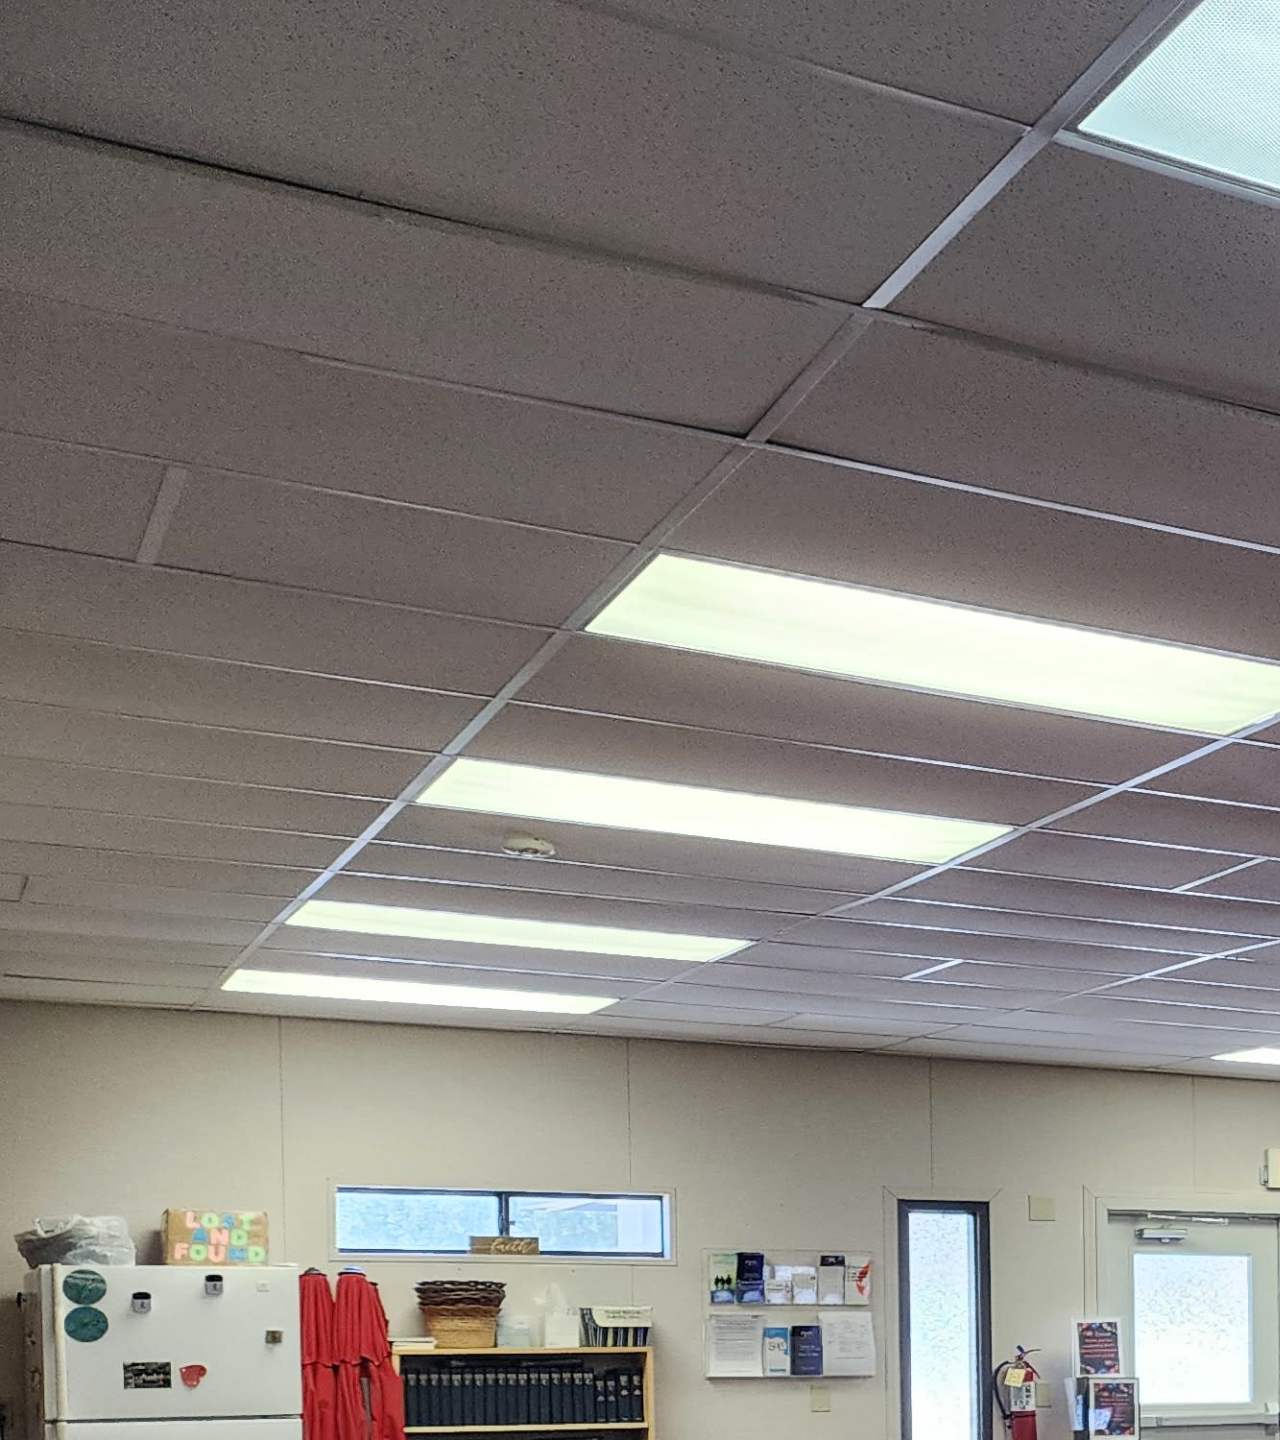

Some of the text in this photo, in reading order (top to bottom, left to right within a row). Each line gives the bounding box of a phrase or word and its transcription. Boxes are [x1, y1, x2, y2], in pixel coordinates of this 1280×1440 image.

[185, 1211, 254, 1231] LOST
[191, 1227, 249, 1247] AND
[173, 1242, 266, 1264] FOUND
